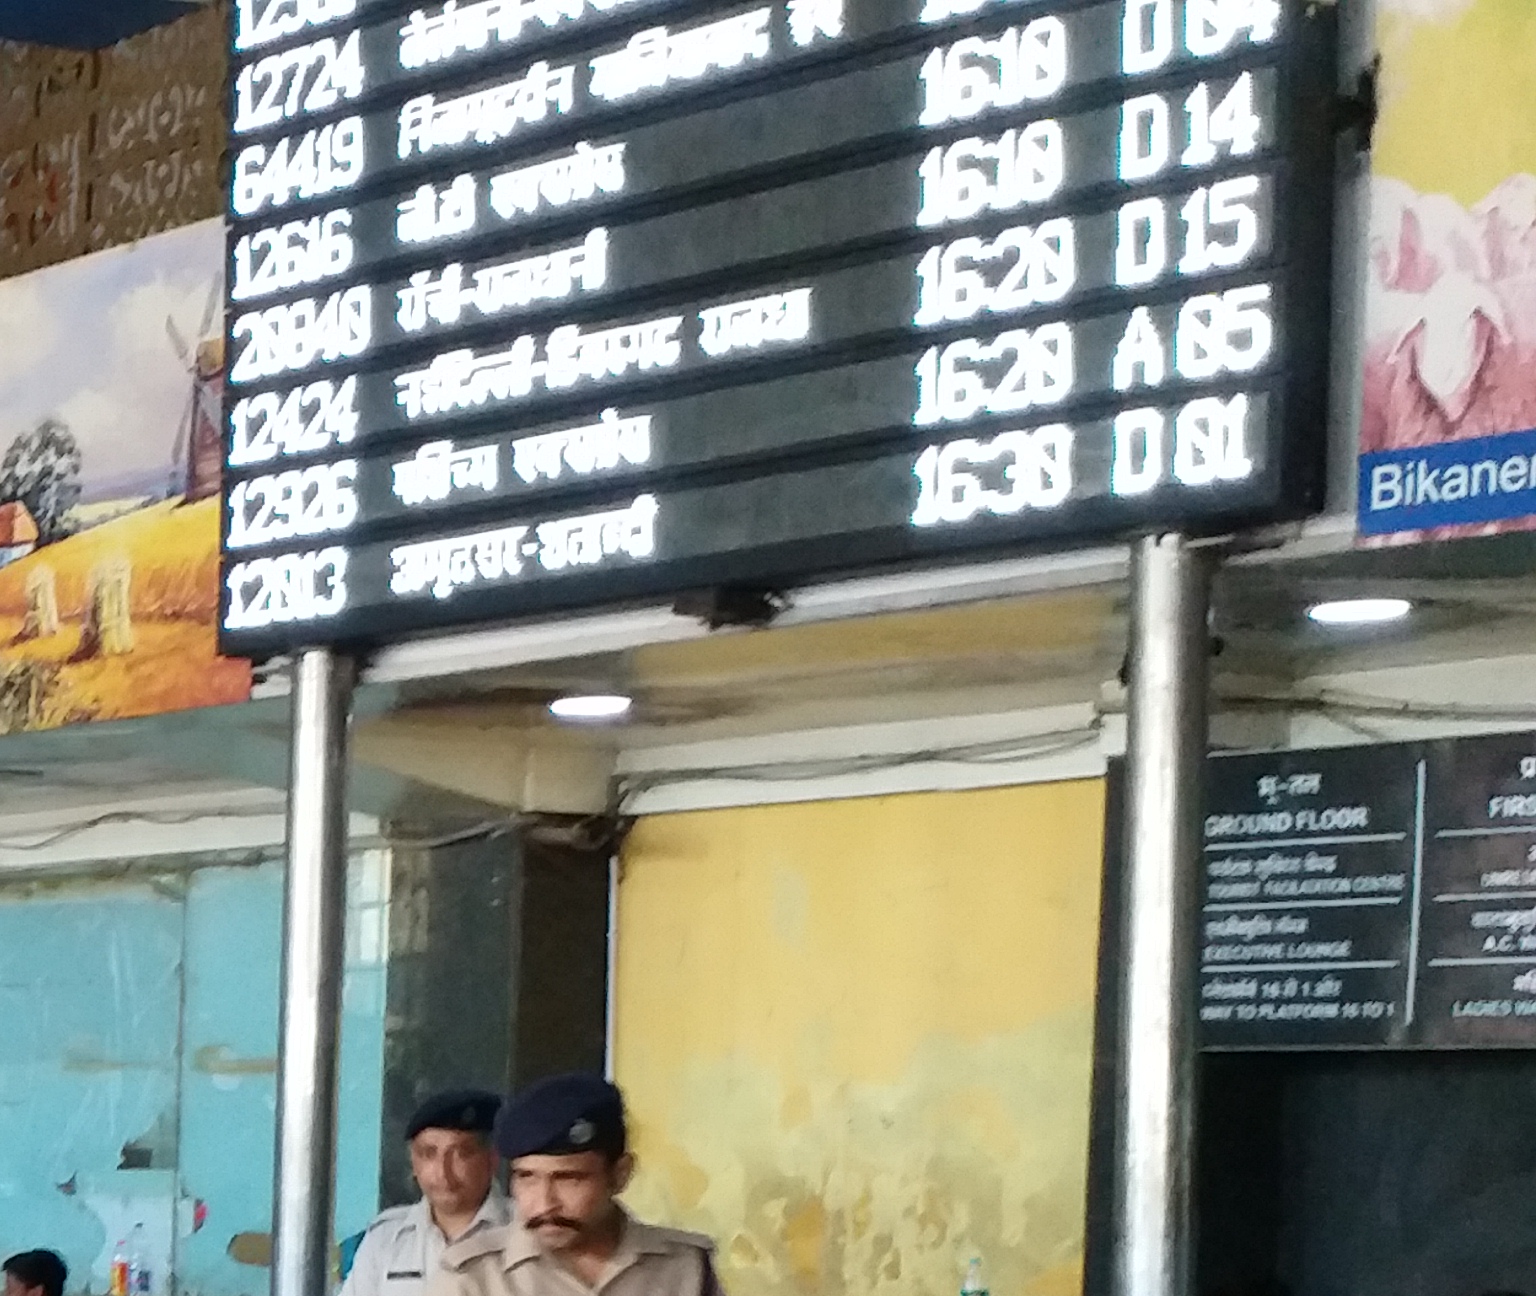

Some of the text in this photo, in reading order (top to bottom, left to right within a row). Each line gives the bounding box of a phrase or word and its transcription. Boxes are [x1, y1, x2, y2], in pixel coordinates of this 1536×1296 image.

[234, 29, 365, 133] 12724
[1118, 93, 1169, 180] D
[1181, 70, 1258, 167] 14
[233, 115, 364, 216] 64419
[232, 208, 354, 299] 12616
[1115, 196, 1167, 289] D
[1177, 175, 1259, 274] 15
[231, 284, 372, 383] 20840
[1112, 305, 1165, 391] A
[1175, 284, 1273, 377] 05
[229, 374, 358, 466] 12424
[1111, 406, 1164, 498] D
[1172, 393, 1251, 486] 01
[227, 458, 358, 548] 12926
[224, 545, 347, 629] 12013
[1204, 806, 1369, 837] GROUND FLOOR
[1286, 940, 1353, 959] LOUNGE
